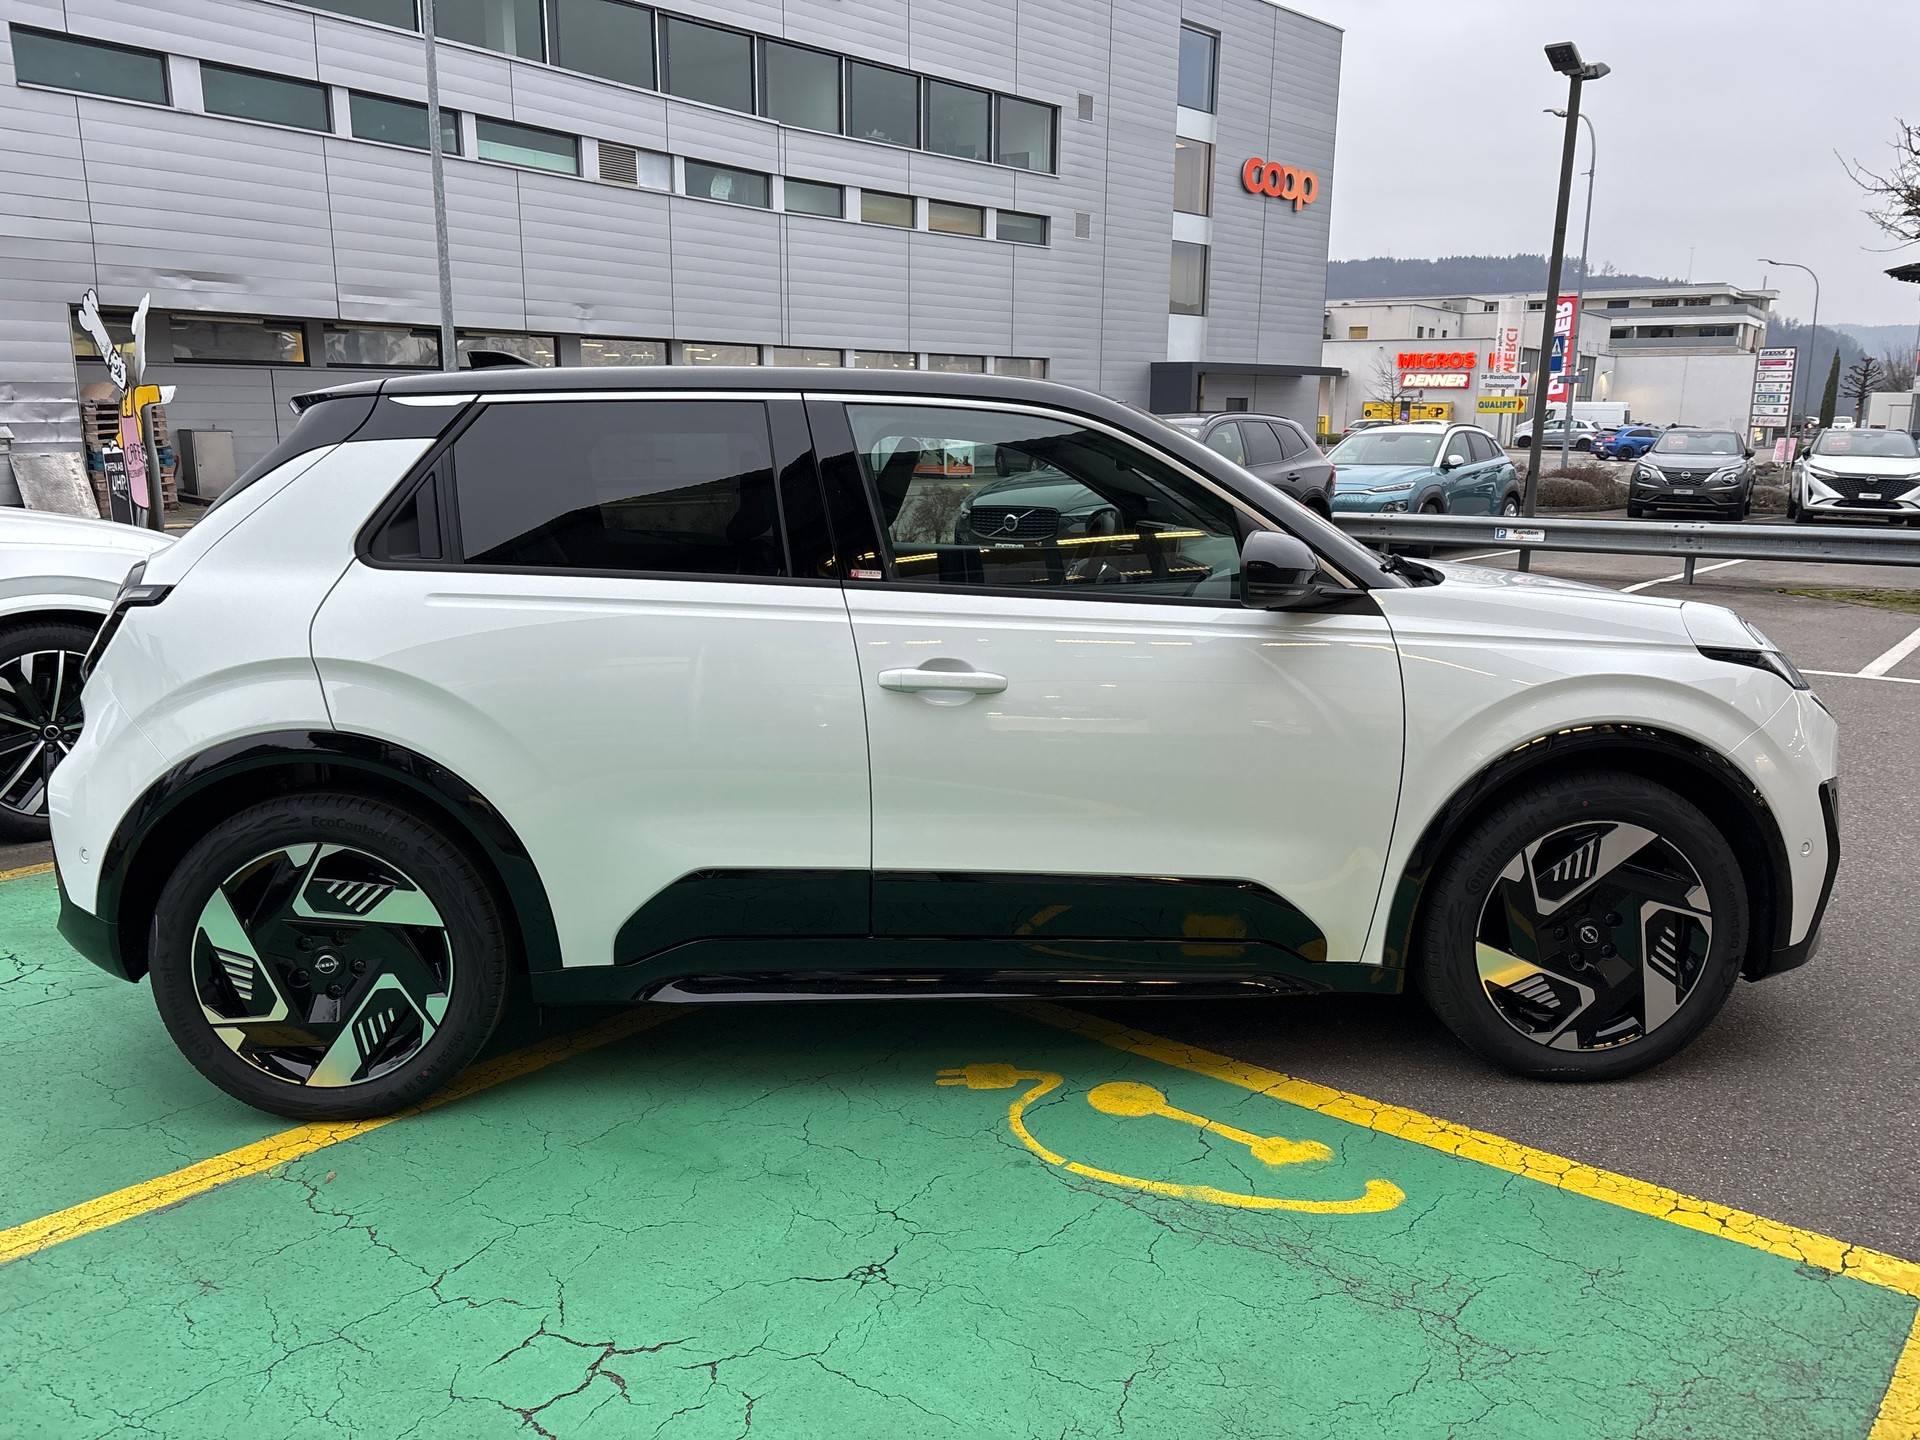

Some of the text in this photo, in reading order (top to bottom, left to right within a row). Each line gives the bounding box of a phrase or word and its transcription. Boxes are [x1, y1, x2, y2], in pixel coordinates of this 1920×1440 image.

[1242, 157, 1318, 211] coop
[1397, 352, 1477, 369] MIGROS
[1403, 374, 1468, 387] DENNER
